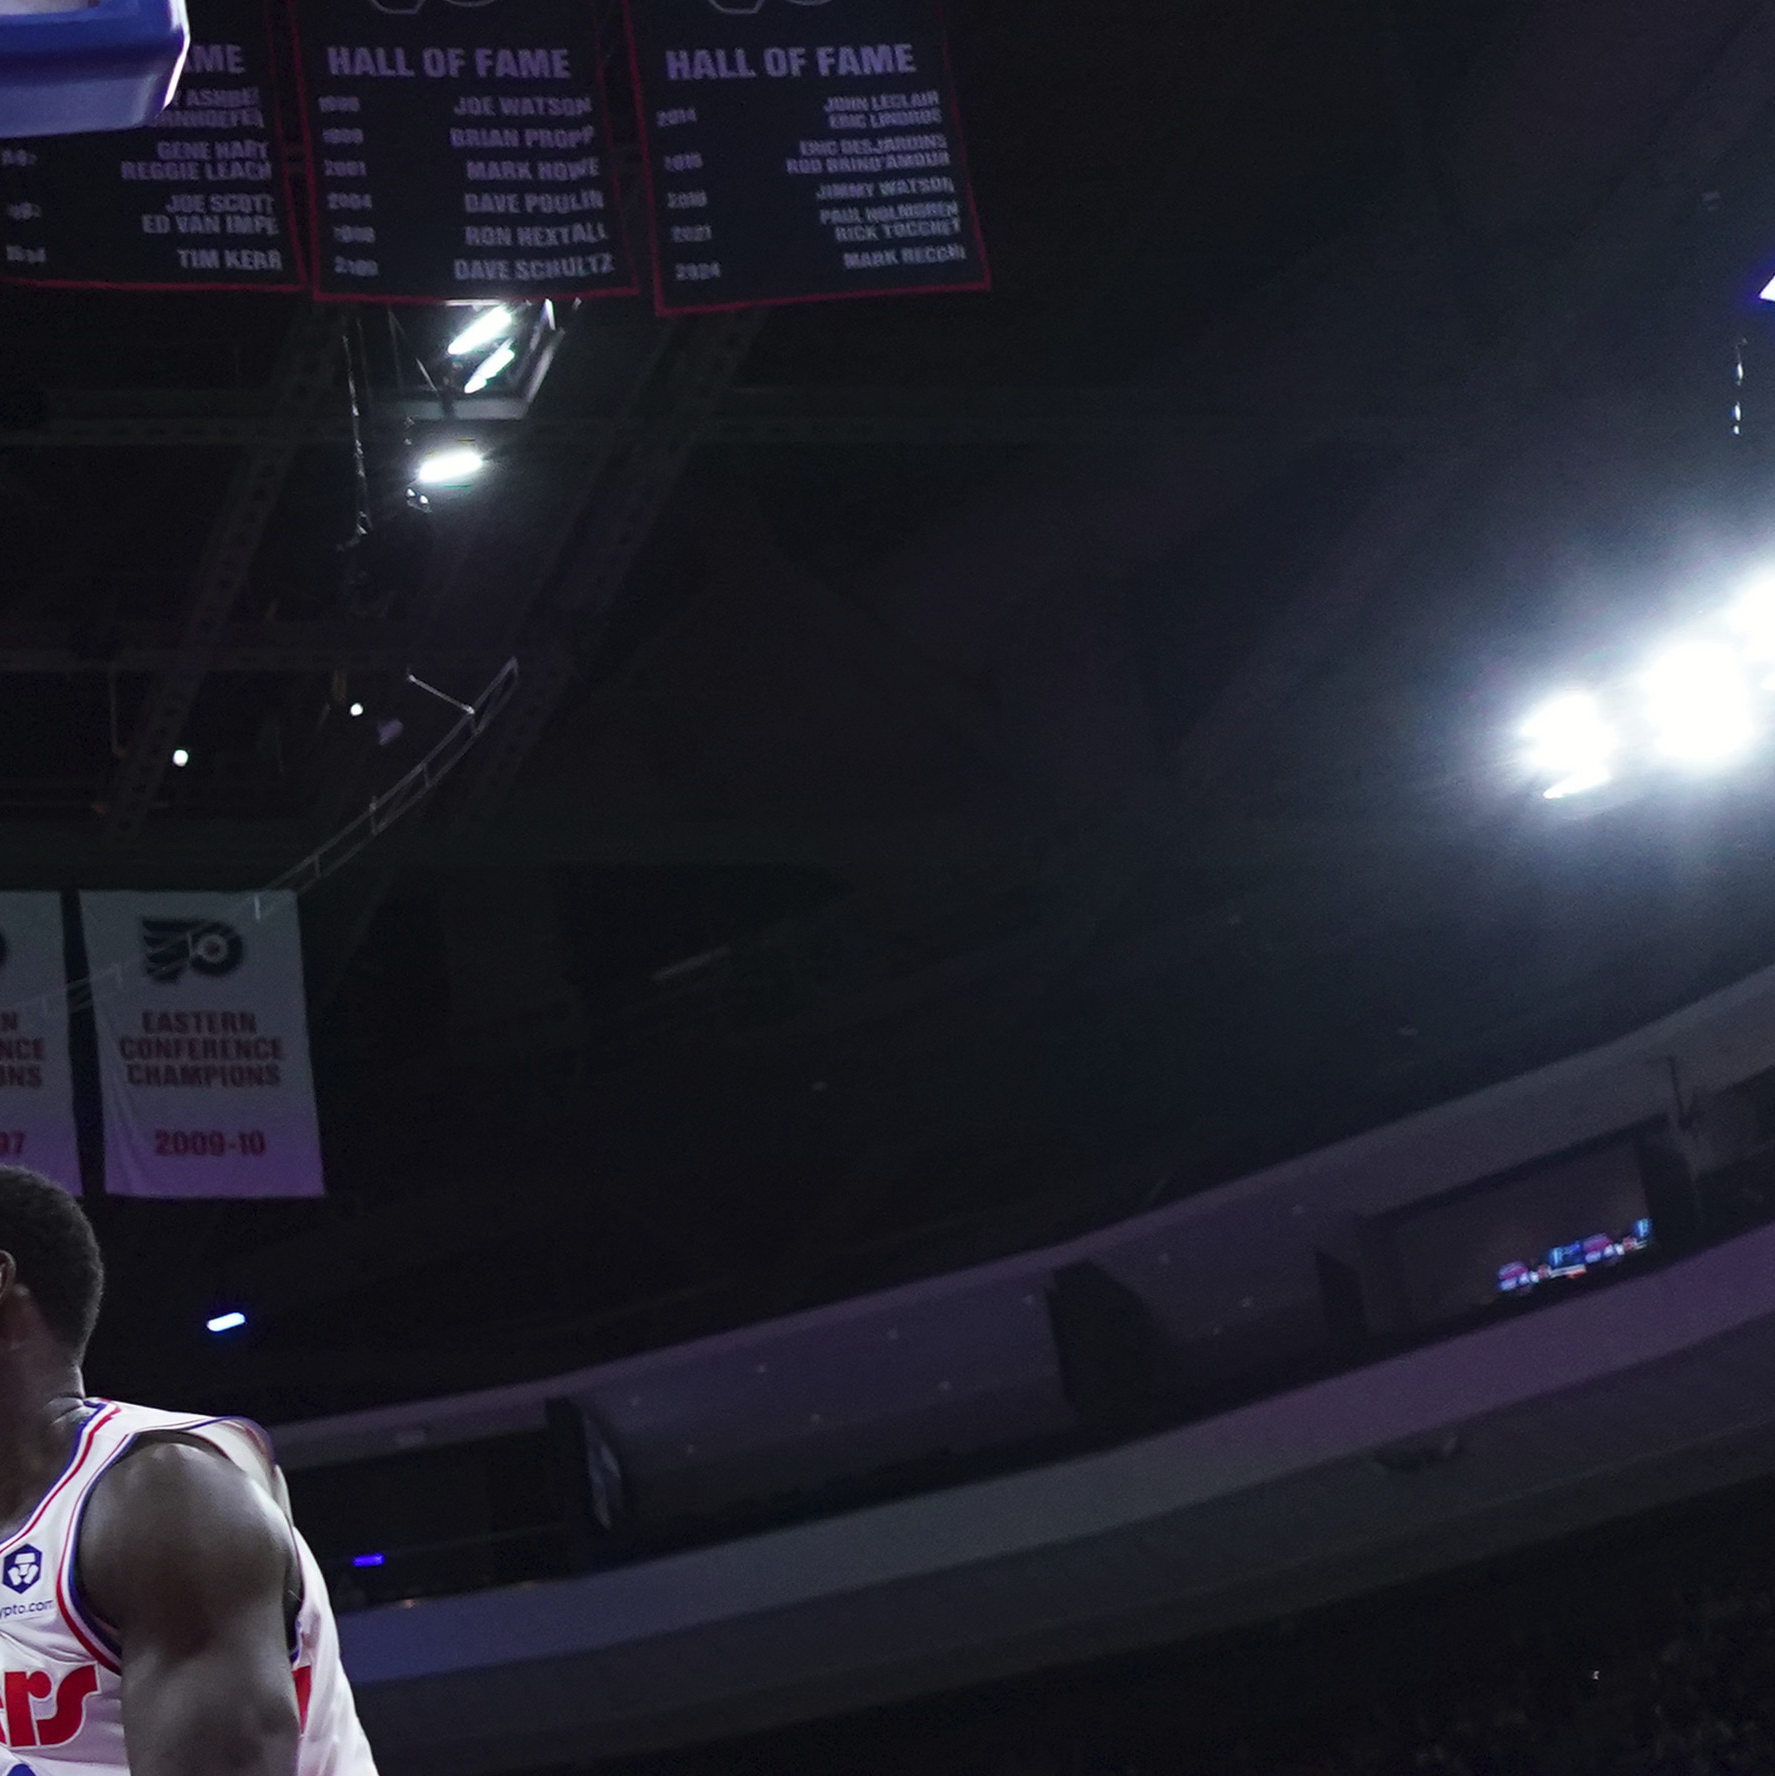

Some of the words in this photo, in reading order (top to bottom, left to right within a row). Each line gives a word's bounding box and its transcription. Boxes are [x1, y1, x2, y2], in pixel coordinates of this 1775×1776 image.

[327, 47, 415, 77] HALL
[423, 47, 466, 78] OF
[475, 48, 572, 79] FAME
[665, 48, 757, 80] HALL
[764, 47, 808, 78] OF
[816, 44, 917, 76] FAME
[141, 1011, 257, 1035] EASTERN
[119, 1037, 284, 1062] CONFERENCE
[127, 1063, 281, 1088] CHAMPIONS
[154, 1130, 266, 1156] 2009-10
